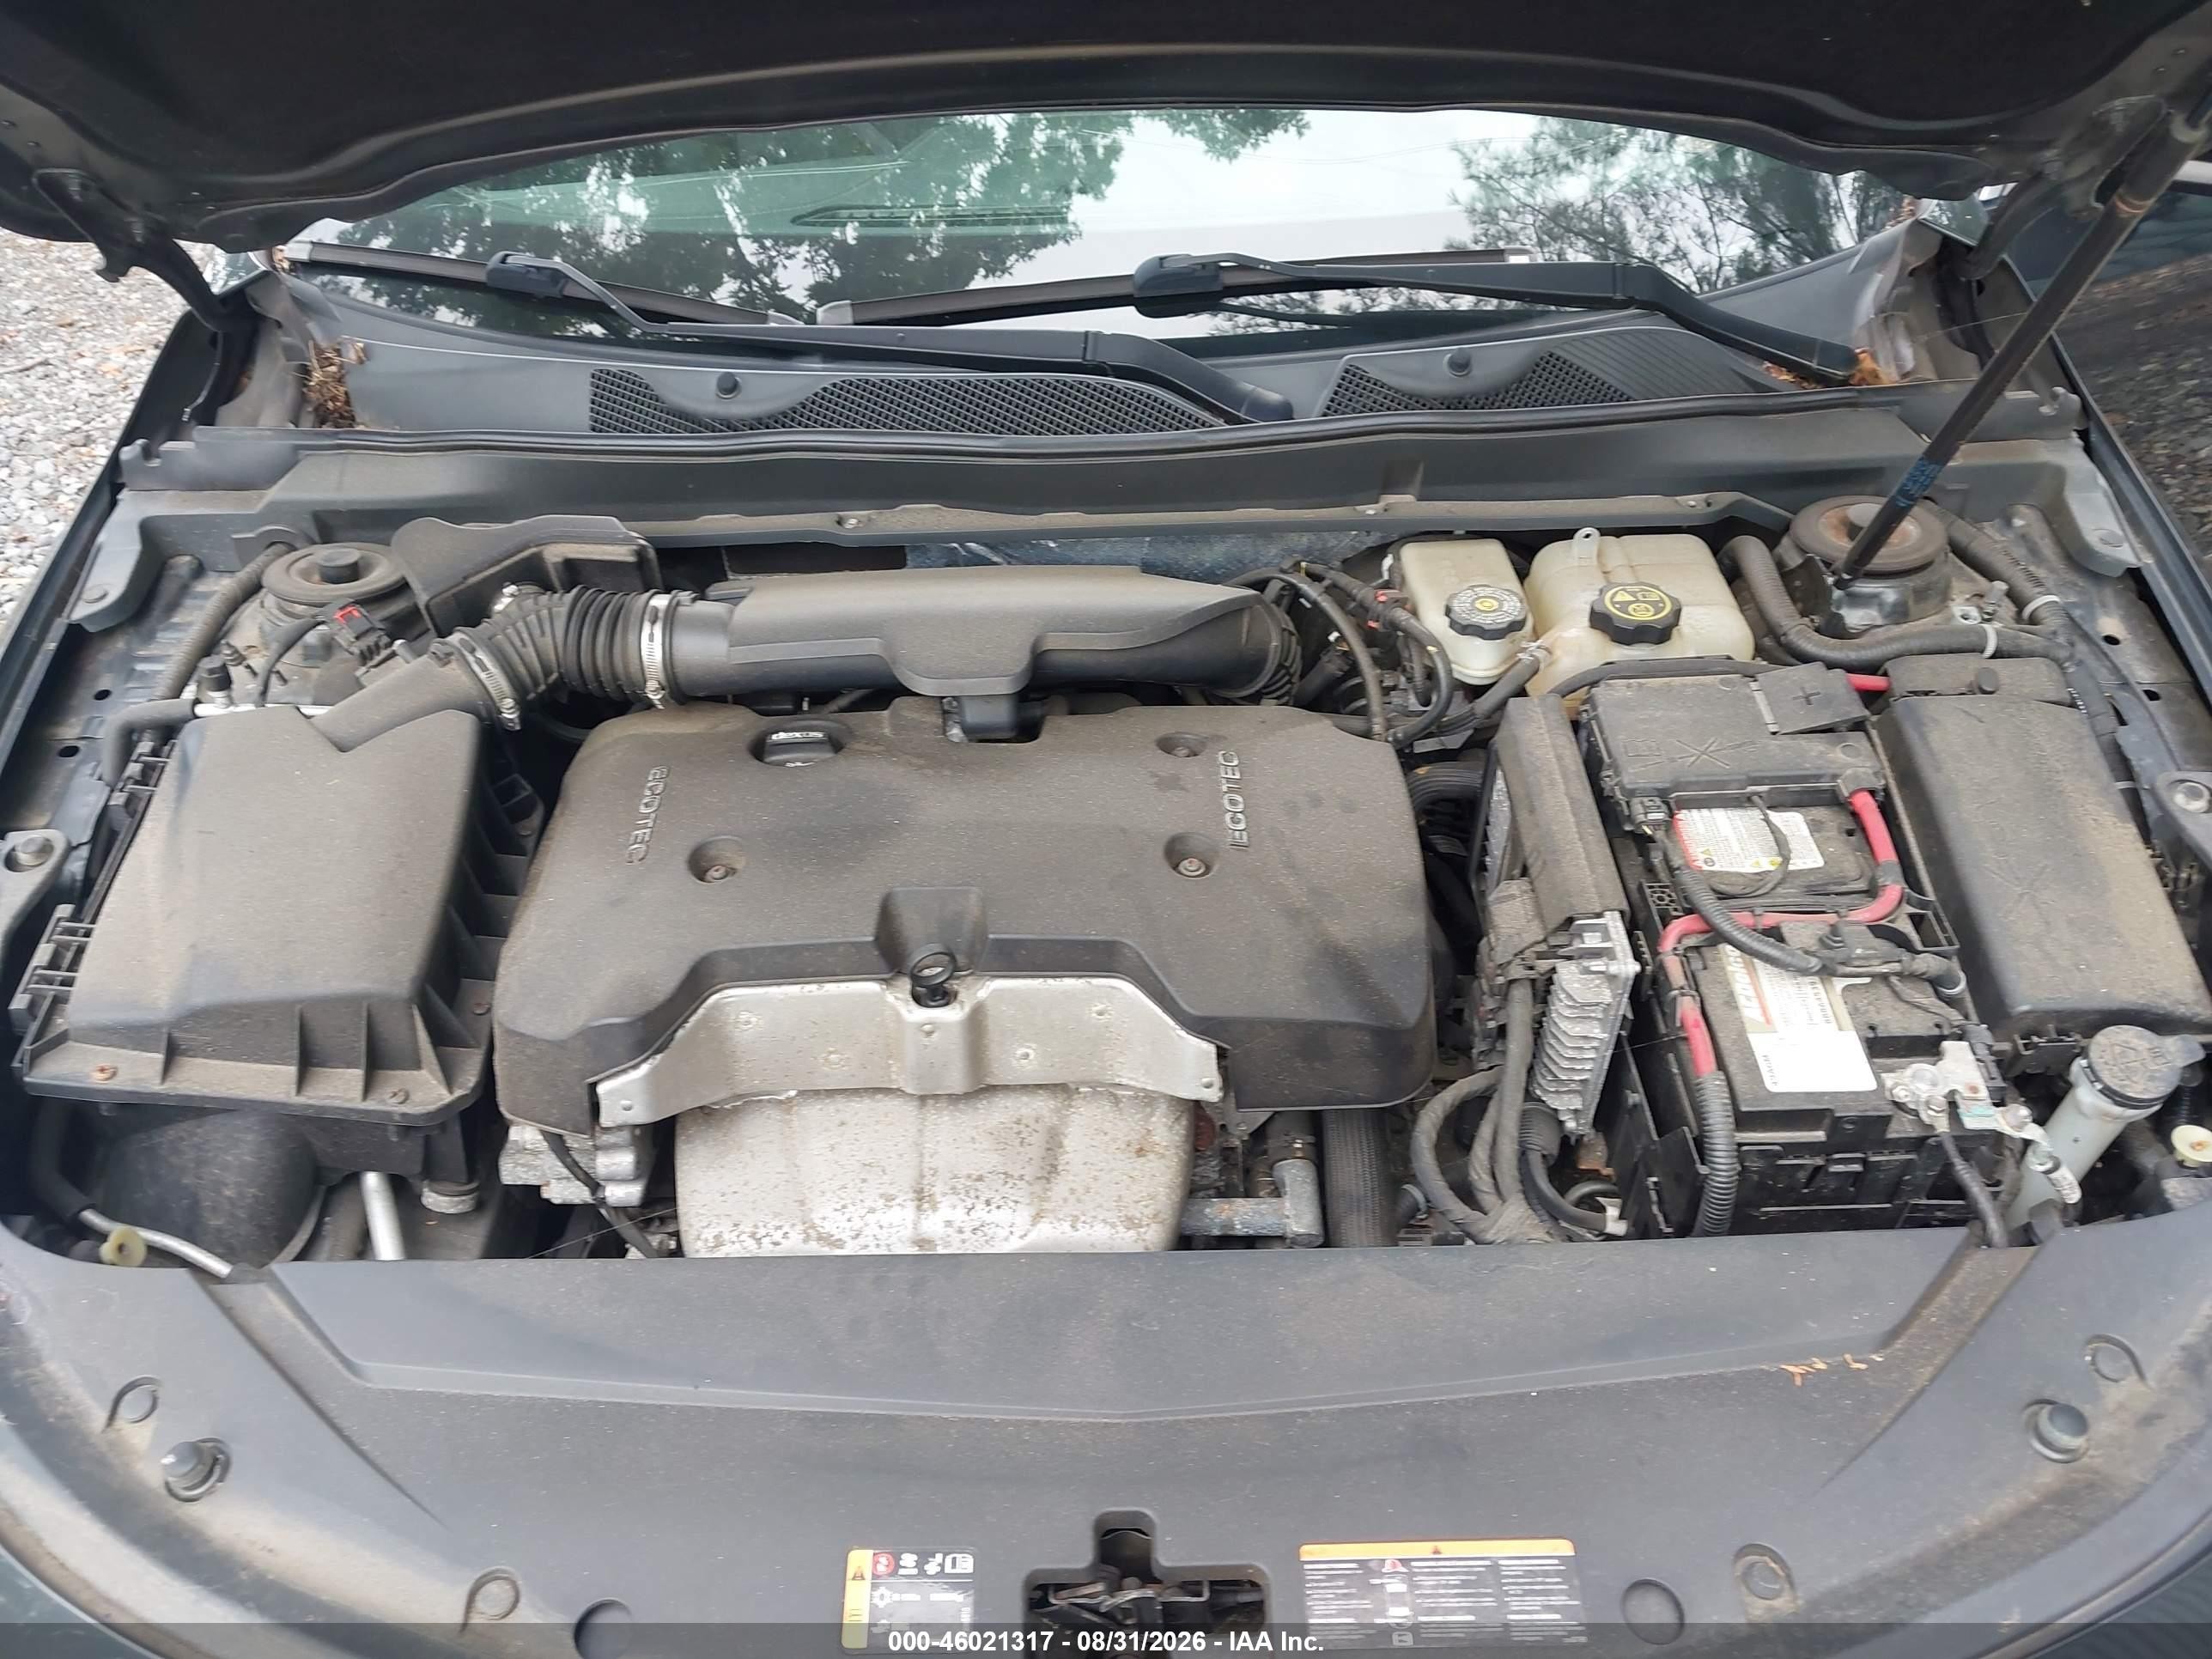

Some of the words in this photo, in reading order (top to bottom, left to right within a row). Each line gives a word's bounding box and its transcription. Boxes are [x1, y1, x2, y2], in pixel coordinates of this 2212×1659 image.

[770, 731, 825, 740] dexos
[624, 764, 671, 866] ECOTEC
[1218, 750, 1249, 849] ECOTEC
